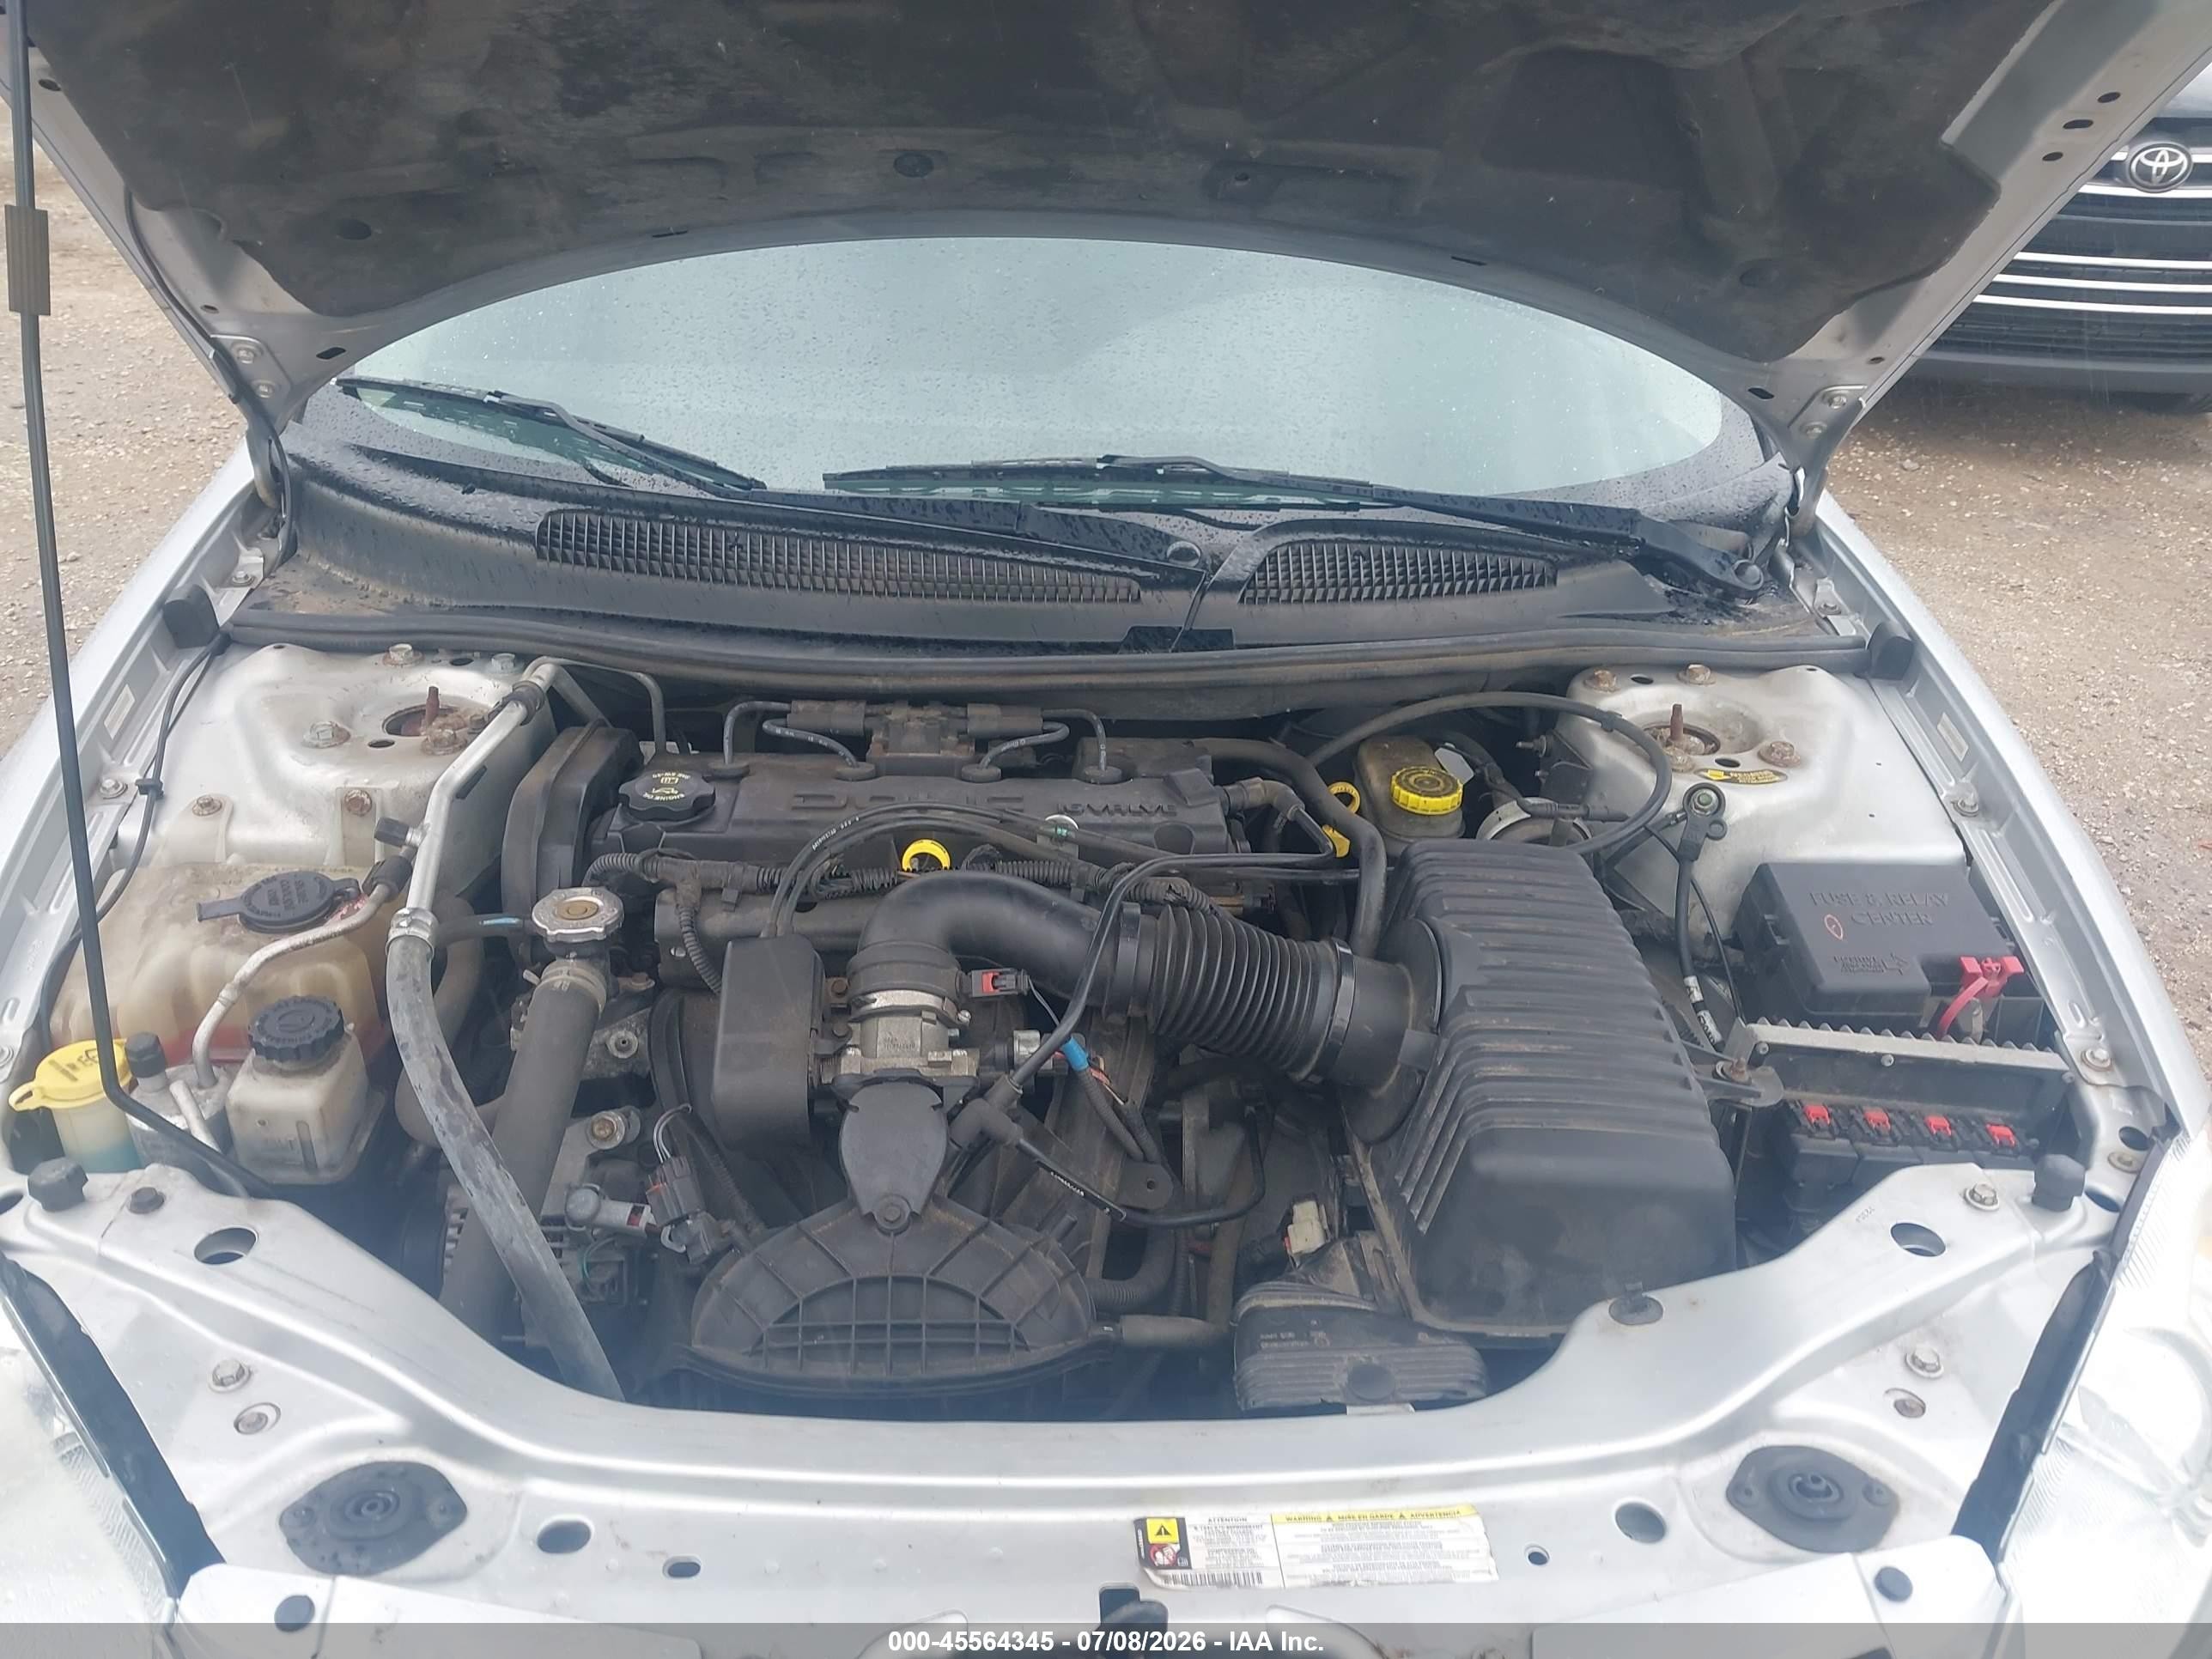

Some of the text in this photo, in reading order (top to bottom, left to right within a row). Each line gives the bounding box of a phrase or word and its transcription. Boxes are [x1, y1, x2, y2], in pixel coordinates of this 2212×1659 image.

[1809, 892, 1948, 907] FUSE & RELAY
[1850, 911, 1935, 926] CENTER
